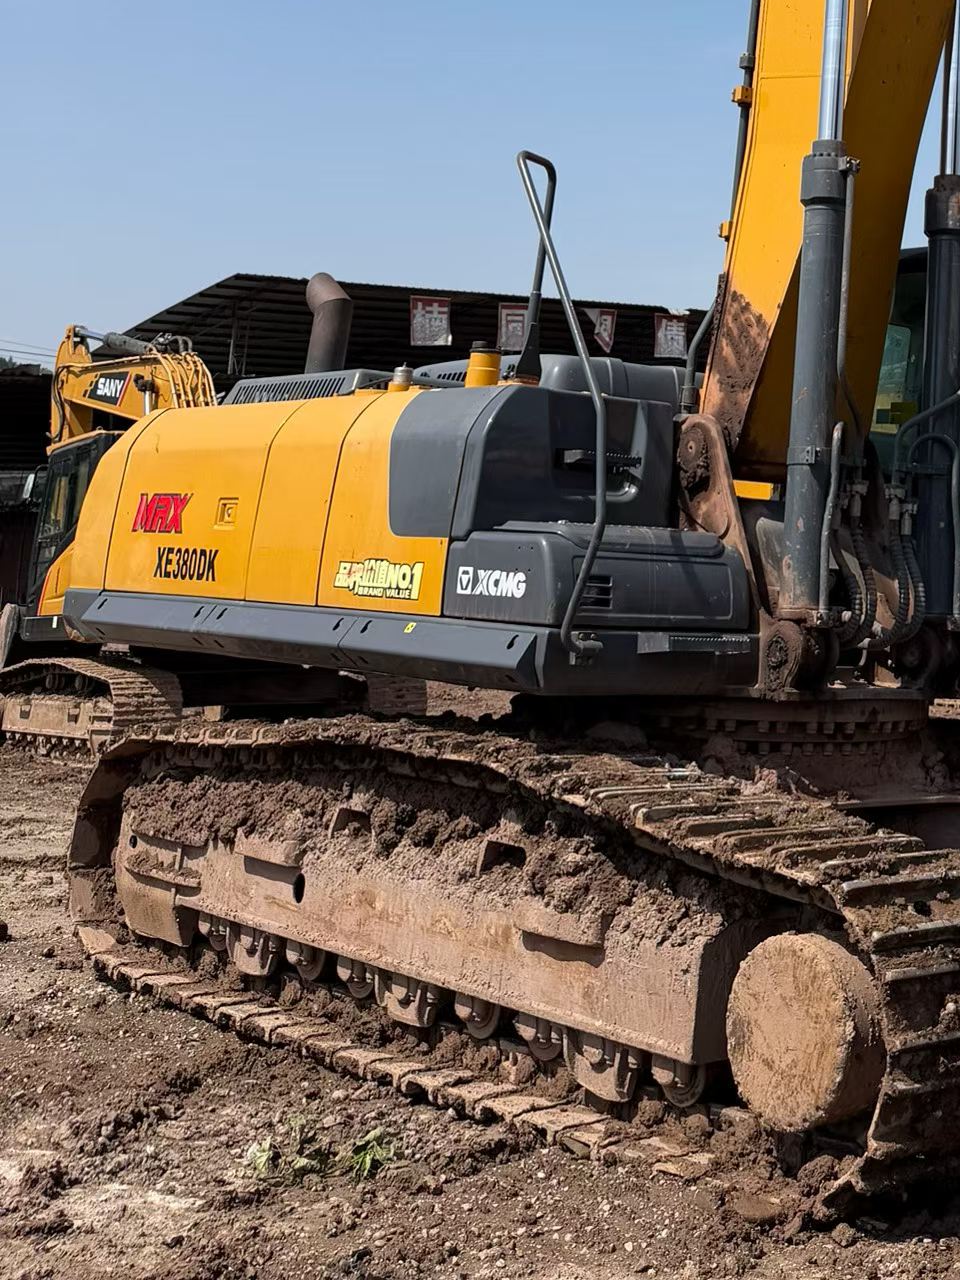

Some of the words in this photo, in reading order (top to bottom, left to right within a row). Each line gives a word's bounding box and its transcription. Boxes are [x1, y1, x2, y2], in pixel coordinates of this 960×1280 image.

[96, 377, 124, 398] SANY
[131, 492, 194, 534] MAX
[153, 546, 219, 582] XE380DK
[358, 586, 384, 598] BRAND
[385, 587, 412, 600] VALUE
[472, 569, 526, 599] XCMG
